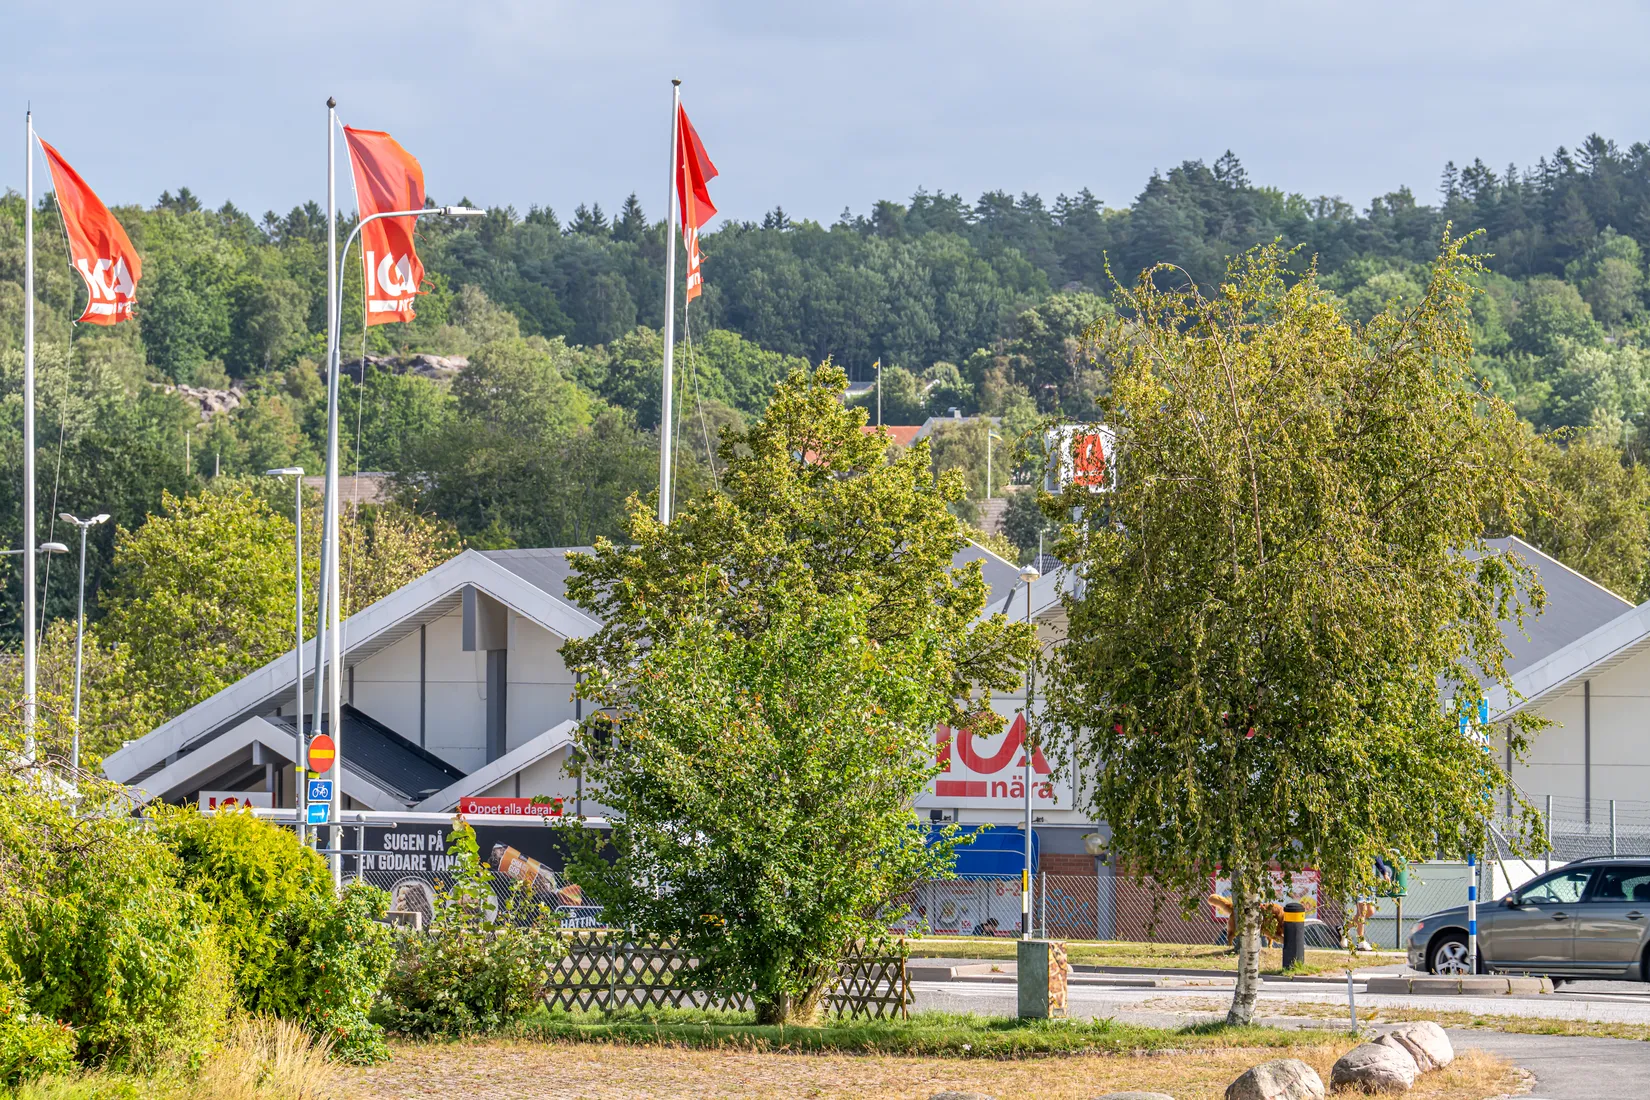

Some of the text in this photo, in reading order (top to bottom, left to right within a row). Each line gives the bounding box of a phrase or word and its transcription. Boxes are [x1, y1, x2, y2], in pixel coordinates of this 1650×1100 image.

[77, 256, 134, 301] ICA
[366, 250, 417, 297] ICA
[936, 711, 1053, 775] ICA
[991, 775, 1053, 799] nära
[468, 801, 553, 817] Öppet alla dagar
[383, 830, 444, 851] SUGEN PÅ
[361, 854, 375, 870] EN
[561, 917, 600, 929] HATTIN
